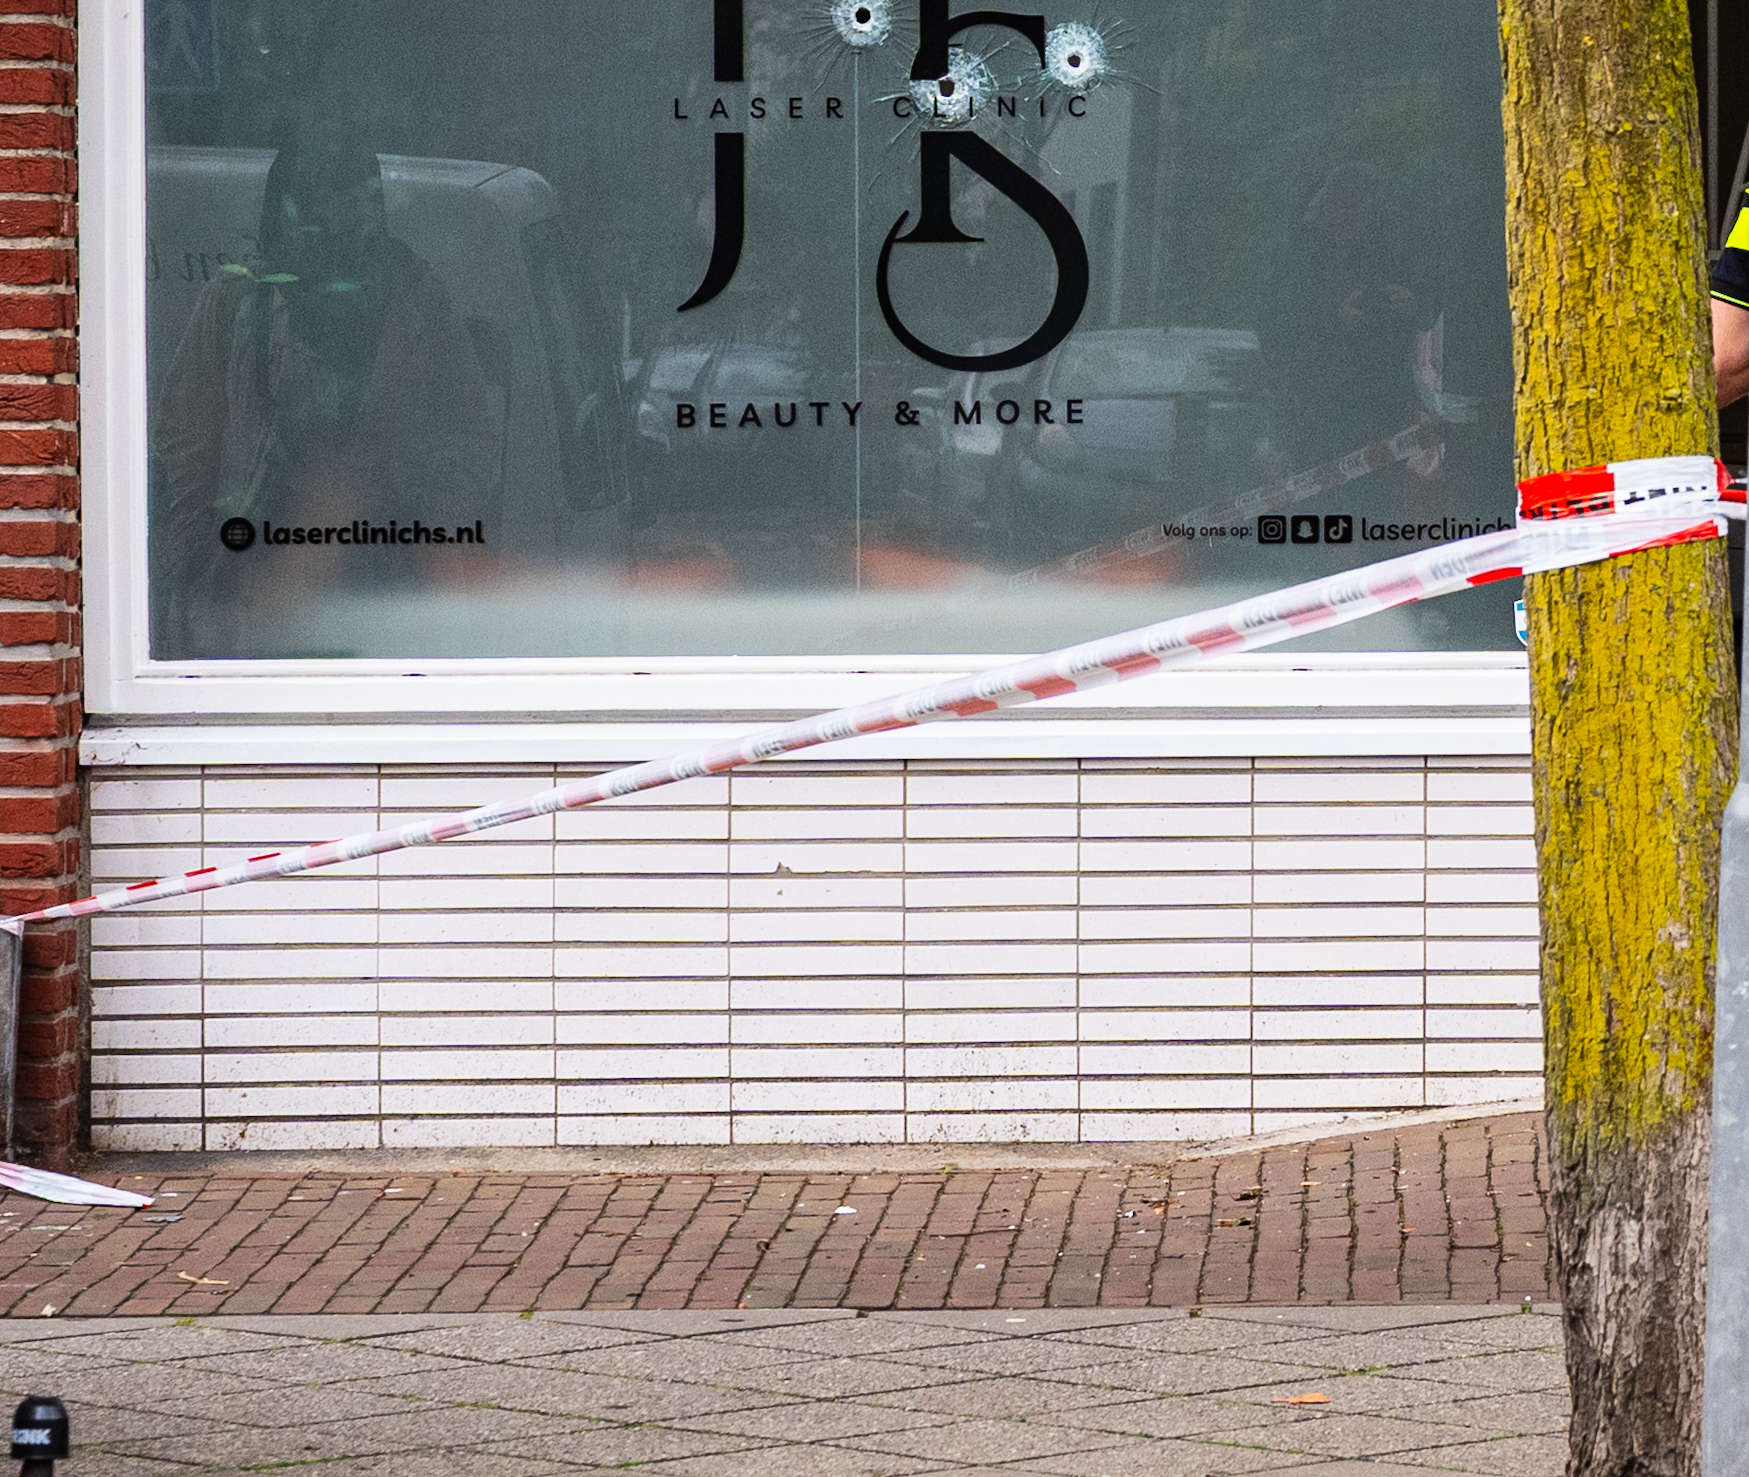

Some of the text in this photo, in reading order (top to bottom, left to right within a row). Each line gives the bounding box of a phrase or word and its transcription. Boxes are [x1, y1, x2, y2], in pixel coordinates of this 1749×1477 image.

[674, 95, 1087, 120] LASER CLINIC
[675, 399, 1085, 427] BEAUTY & MORE
[263, 519, 485, 545] laserclinichs.nl
[1162, 523, 1195, 540] Volg
[1199, 525, 1227, 538] ons
[1230, 525, 1252, 539] op:
